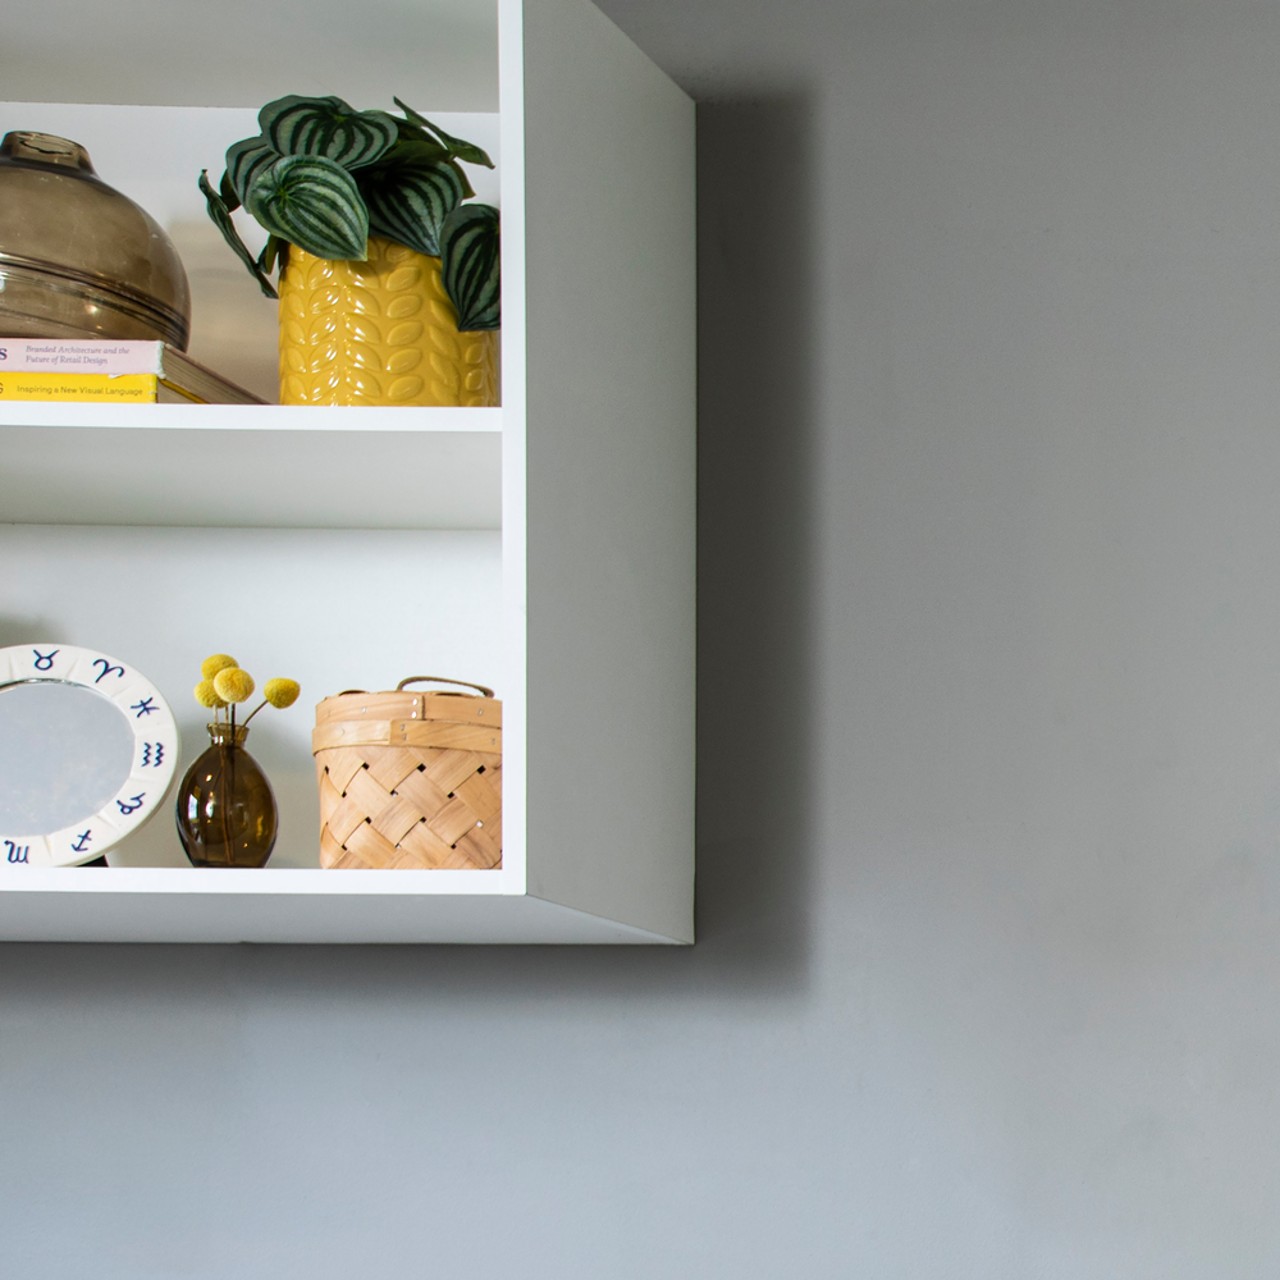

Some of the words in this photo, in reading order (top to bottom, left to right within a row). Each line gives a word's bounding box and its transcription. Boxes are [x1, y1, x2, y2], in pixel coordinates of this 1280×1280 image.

[26, 345, 57, 353] Branded
[58, 346, 101, 354] Architecture
[26, 355, 50, 363] Future
[51, 355, 59, 365] of
[60, 356, 82, 364] Retail
[83, 356, 108, 366] Design
[17, 385, 53, 395] Inspiring
[60, 386, 78, 394] New
[79, 386, 104, 395] Visual
[105, 387, 143, 397] Language
